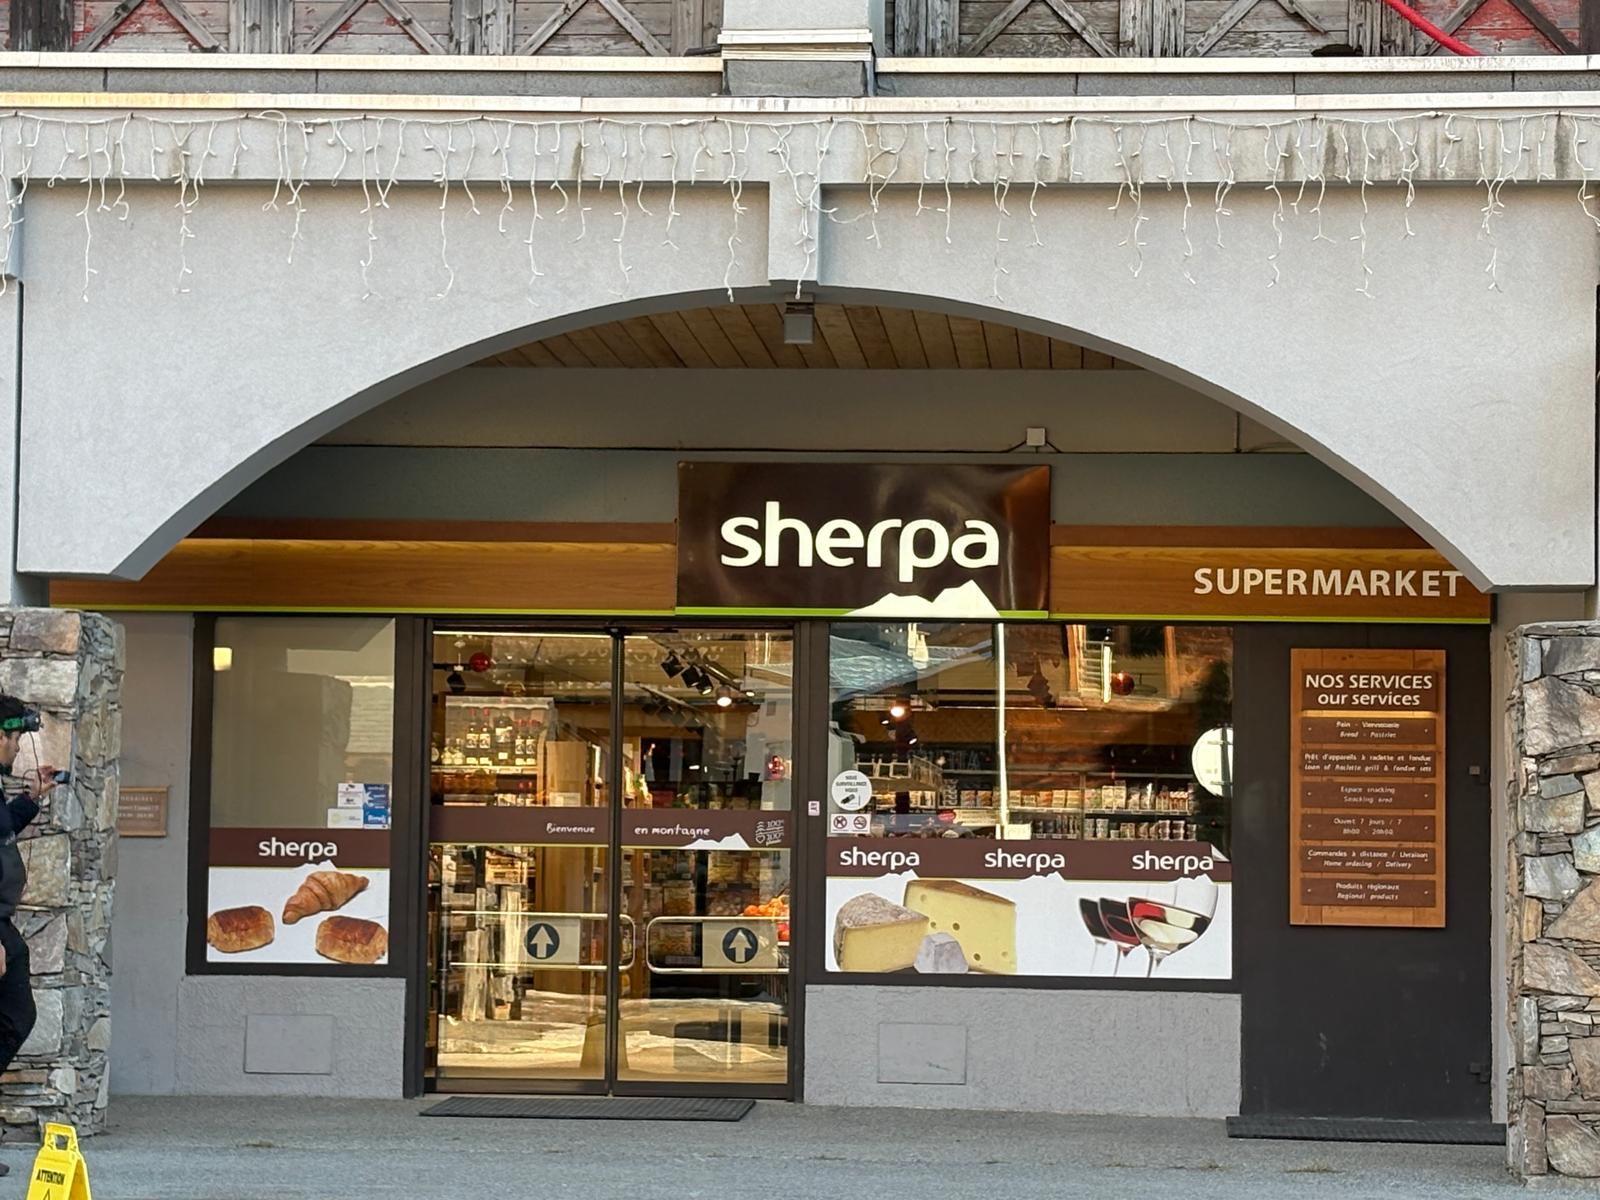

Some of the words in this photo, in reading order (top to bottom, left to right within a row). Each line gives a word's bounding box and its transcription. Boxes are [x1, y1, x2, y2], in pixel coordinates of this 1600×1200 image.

[720, 500, 1000, 582] sherpa
[1193, 567, 1464, 598] SUPERMARKET
[1306, 675, 1344, 688] NOS
[1349, 675, 1432, 689] SERVICES
[1318, 693, 1348, 705] our
[1352, 692, 1420, 705] services
[546, 822, 597, 834] Bienvenue
[634, 827, 649, 836] en
[651, 824, 711, 839] montagne
[258, 836, 338, 861] sherpa
[839, 846, 921, 871] sherpa
[984, 848, 1066, 873] sherpa
[1132, 850, 1214, 875] sherpa
[1386, 861, 1412, 869] Delivery
[36, 1169, 66, 1185] ATTENTION
